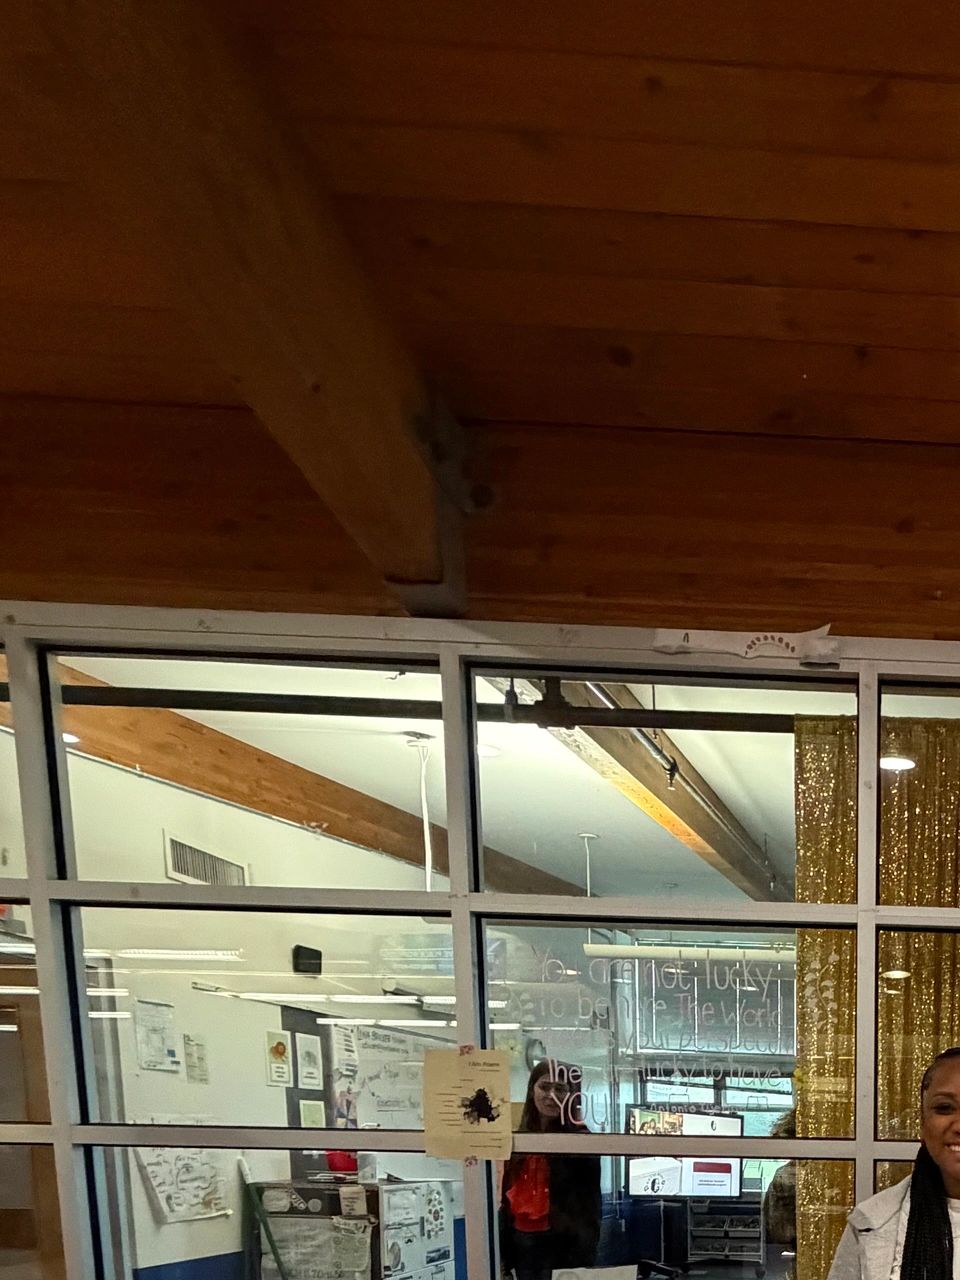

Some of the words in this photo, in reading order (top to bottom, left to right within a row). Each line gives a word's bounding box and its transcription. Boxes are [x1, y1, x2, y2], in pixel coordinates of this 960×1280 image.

[641, 949, 691, 990] not
[706, 949, 773, 1002] lucky
[673, 993, 715, 1026] The
